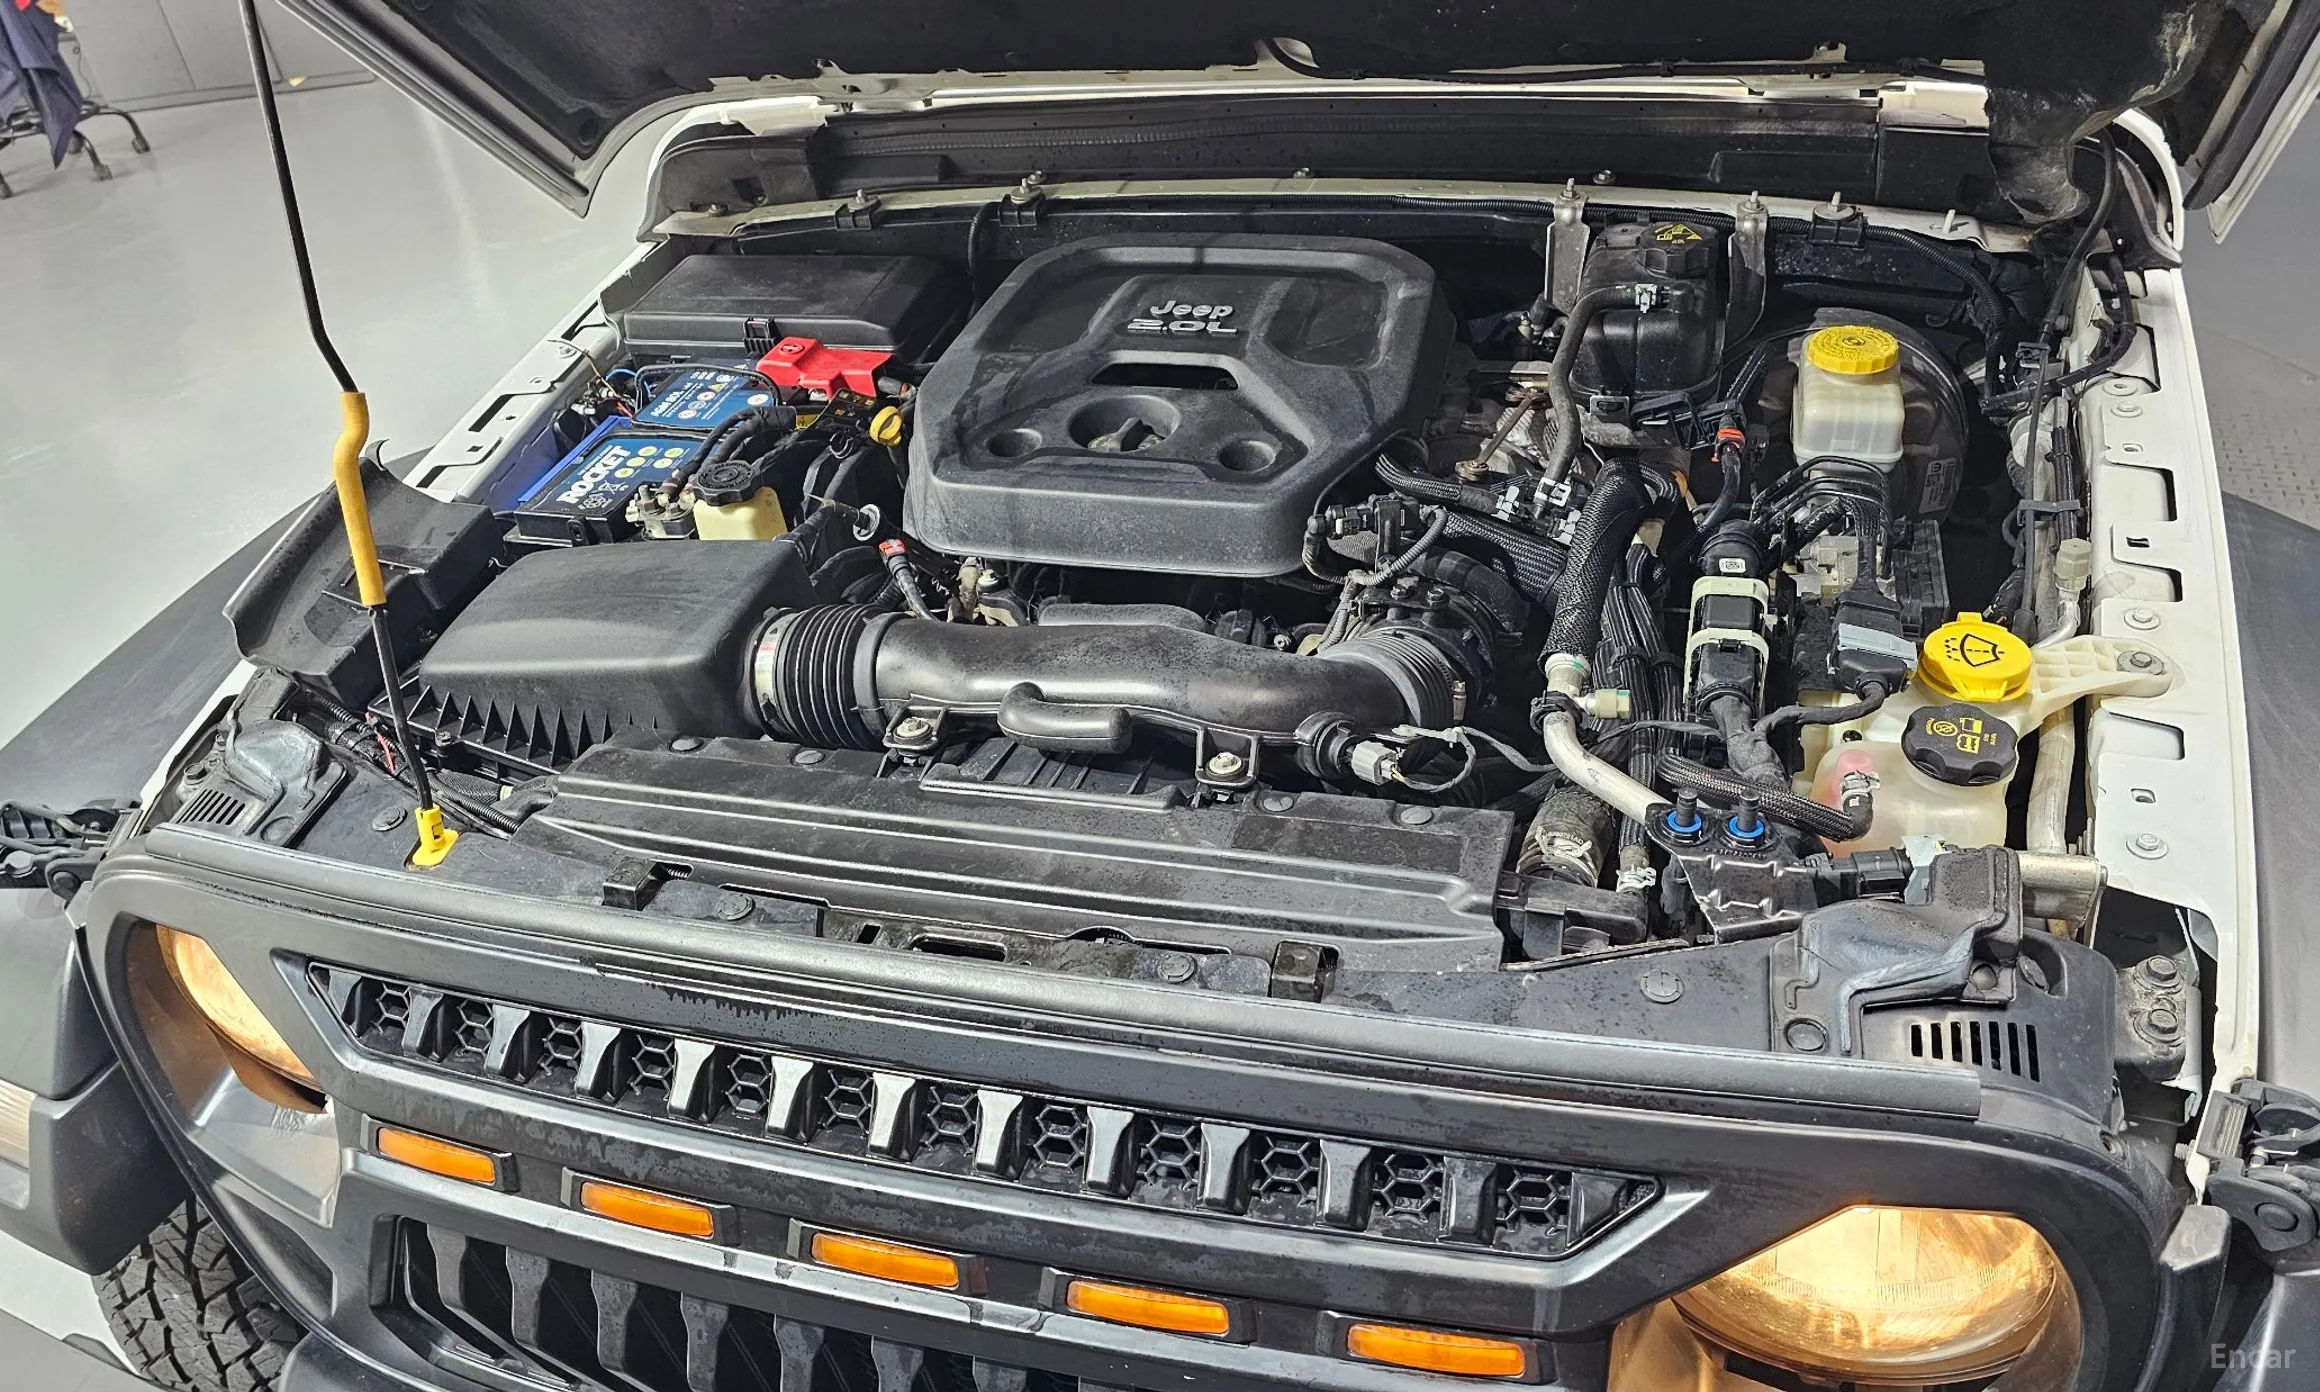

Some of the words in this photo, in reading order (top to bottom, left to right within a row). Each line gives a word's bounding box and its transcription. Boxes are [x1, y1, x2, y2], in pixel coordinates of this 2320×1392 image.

[1150, 300, 1233, 319] Jeep
[1127, 318, 1238, 333] 2.0L
[651, 402, 672, 417] AGM
[556, 445, 631, 504] ROCKET
